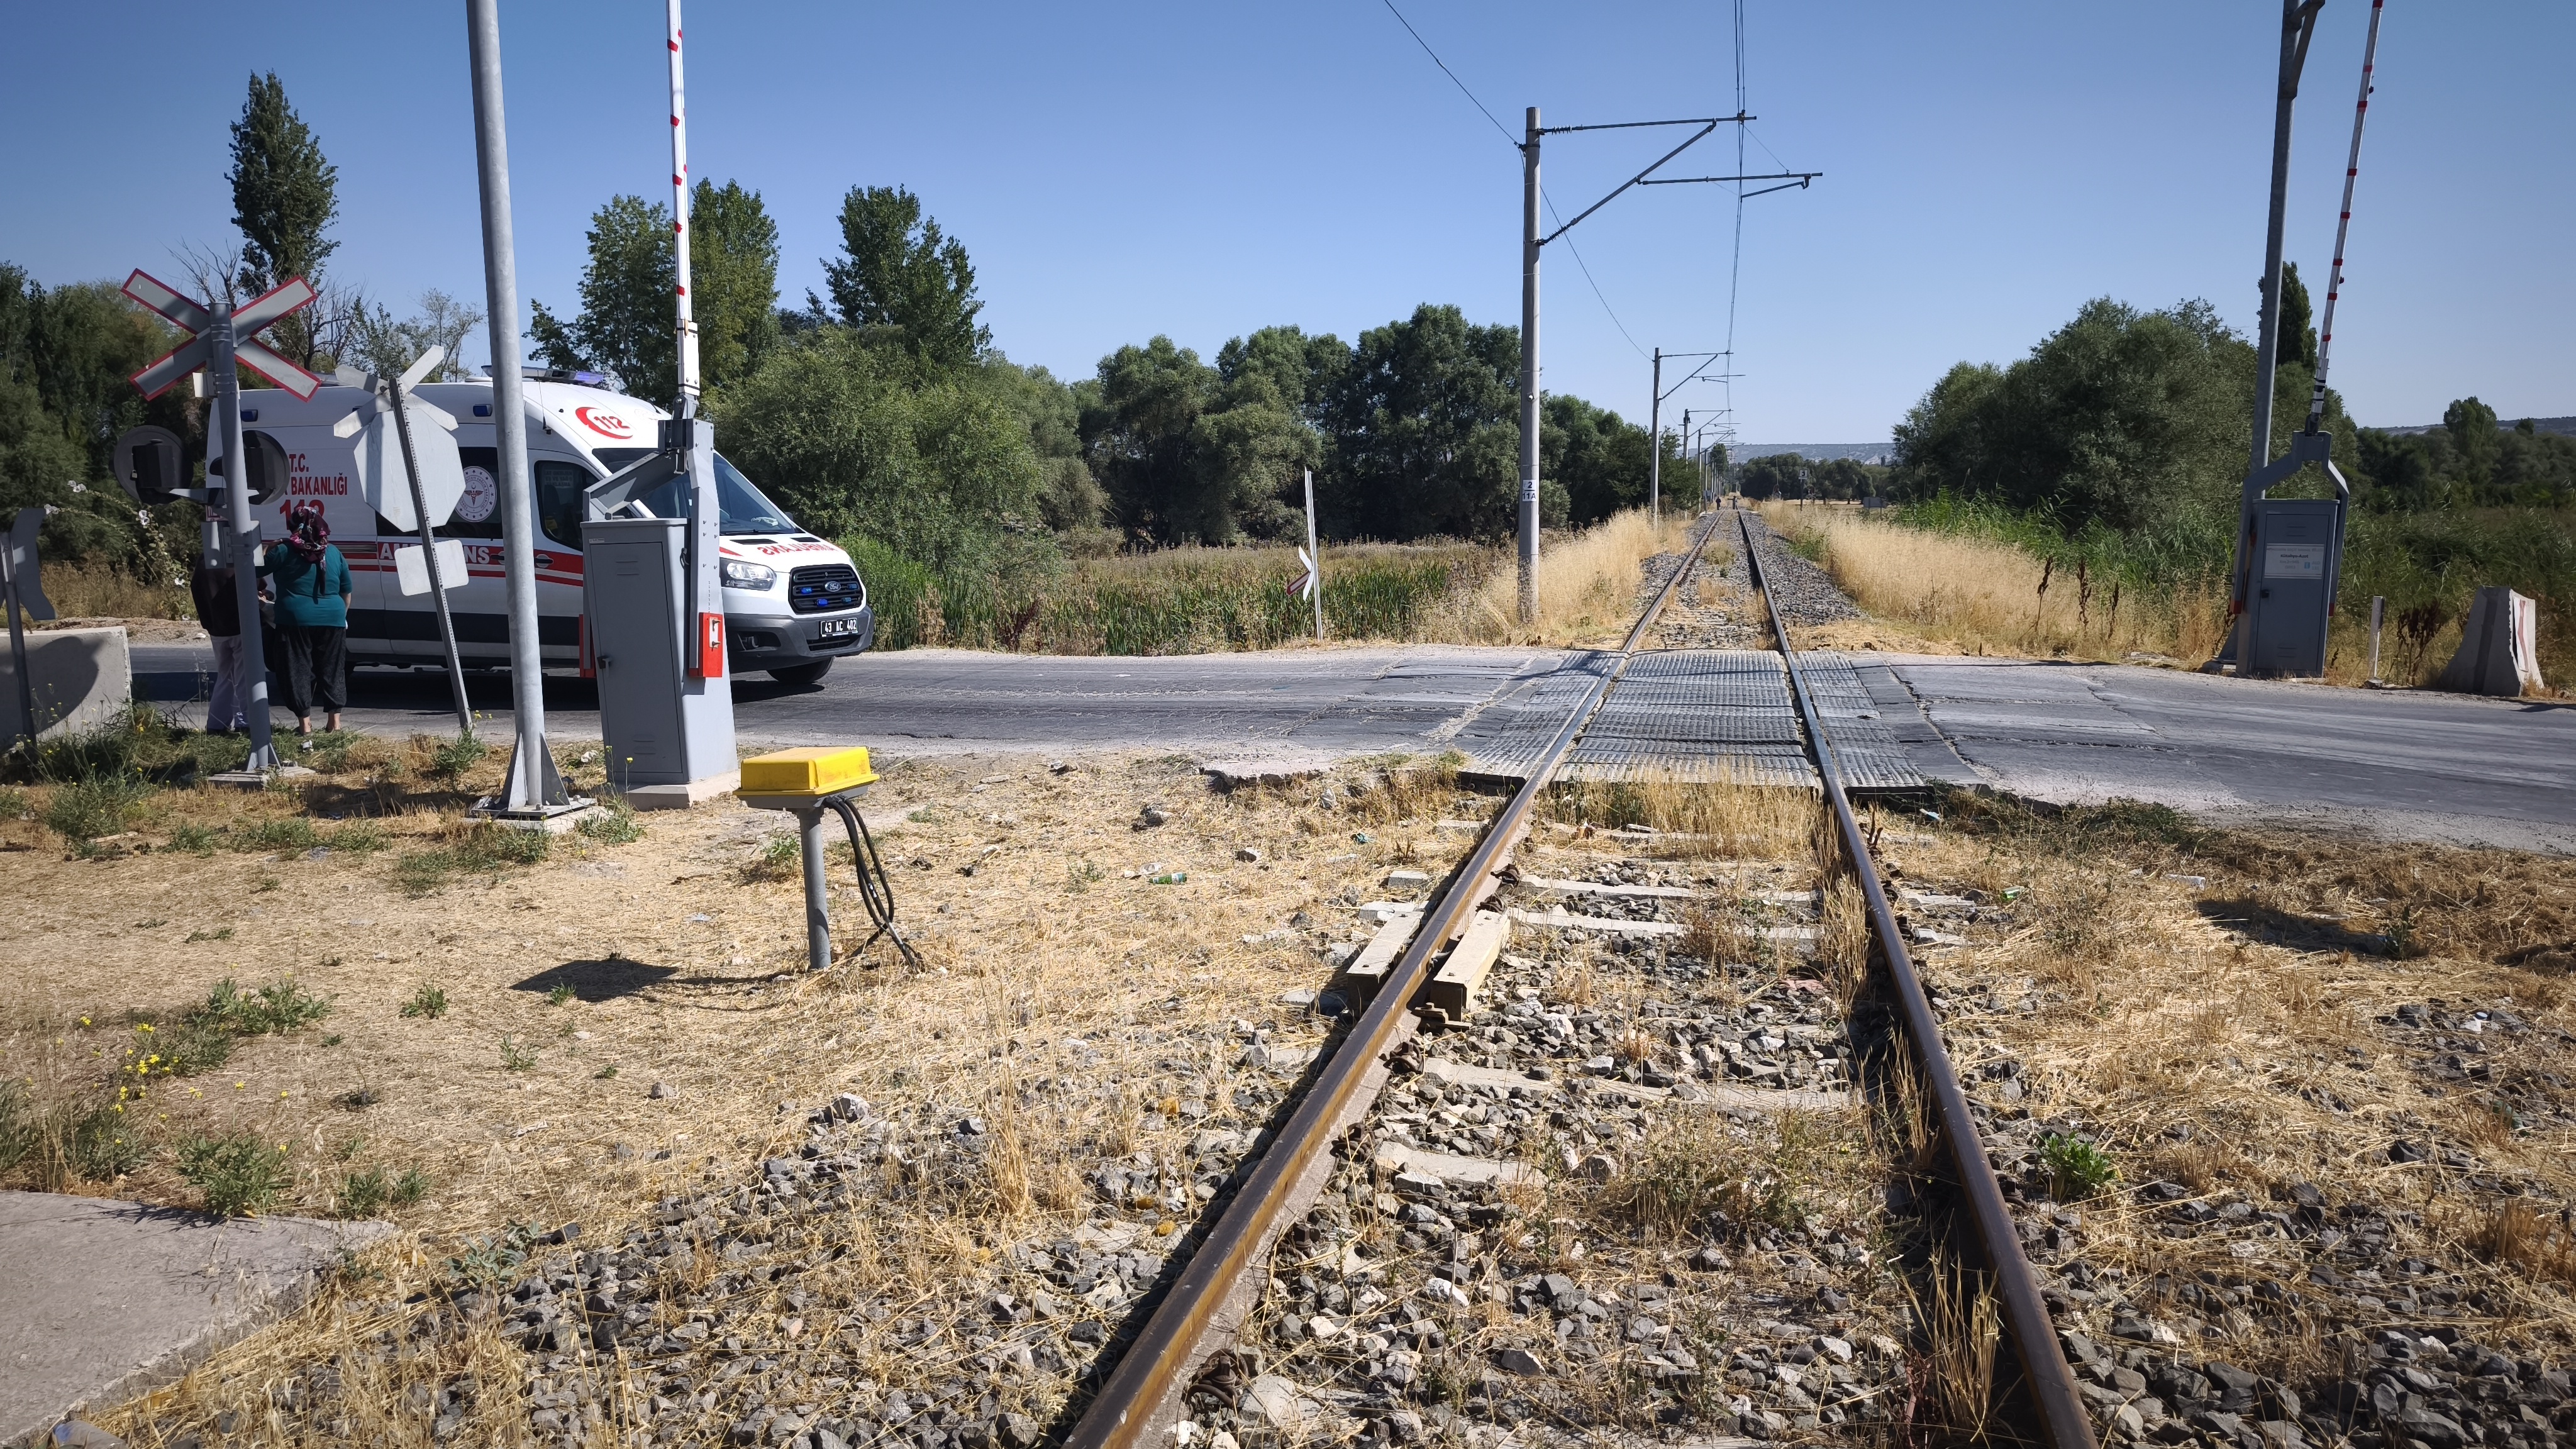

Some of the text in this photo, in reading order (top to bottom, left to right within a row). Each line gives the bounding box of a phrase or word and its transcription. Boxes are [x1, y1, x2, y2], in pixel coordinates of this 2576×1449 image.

[594, 416, 631, 429] 112
[289, 453, 309, 472] T.C.
[291, 472, 348, 496] BAKANLIĞI
[824, 622, 832, 633] 43
[847, 619, 857, 631] 402
